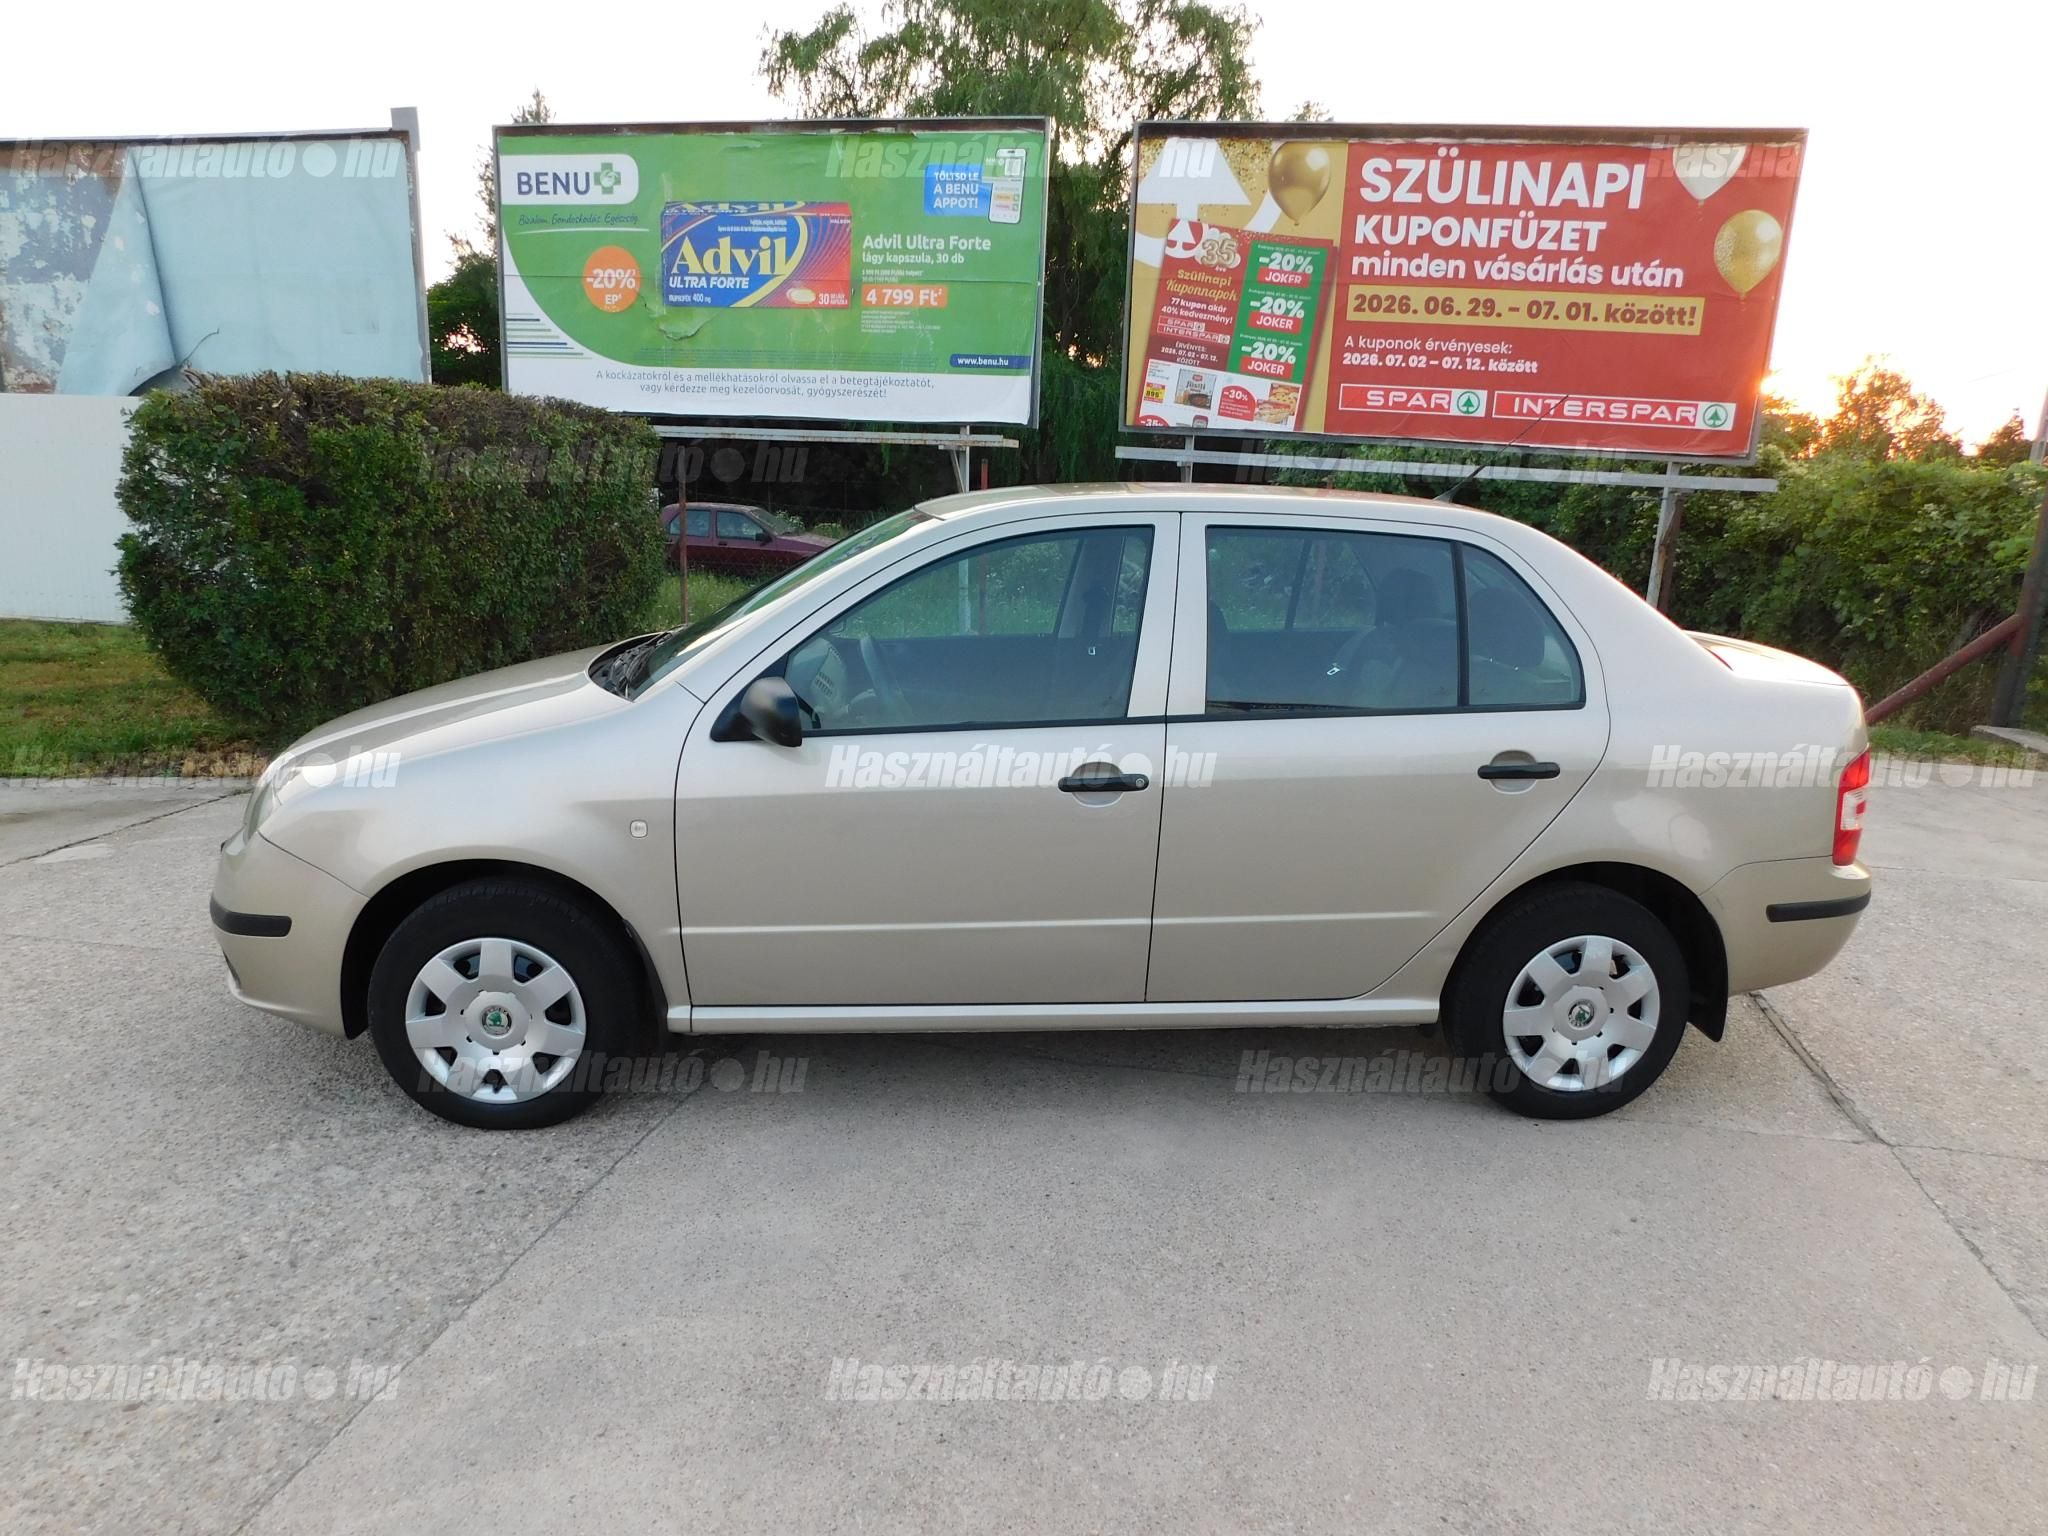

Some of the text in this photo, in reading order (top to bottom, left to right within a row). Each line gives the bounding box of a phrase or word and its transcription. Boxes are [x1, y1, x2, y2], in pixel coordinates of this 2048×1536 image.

[516, 172, 590, 196] BENU
[933, 170, 979, 181] TÖLTSD LE
[1360, 147, 1646, 210] SZÜLINAPI
[933, 184, 979, 195] A BENU
[933, 198, 978, 209] APPOT!
[1355, 210, 1607, 252] KUPONFÜZET
[862, 234, 991, 250] Advil Ultra Forte
[671, 236, 786, 275] Advil
[862, 251, 965, 265] lágy kapszula, 30 db
[1259, 252, 1314, 274] -20%
[1351, 250, 1684, 288] minden vásárlás után
[669, 276, 750, 289] ULTRA FORTE
[1177, 269, 1232, 288] Szülinapi
[1264, 271, 1302, 285] JOKER
[818, 293, 829, 305] 30
[866, 288, 877, 305] 4
[882, 288, 914, 305] 799
[1180, 298, 1207, 310] kupon
[1250, 296, 1305, 319] -20%
[1353, 293, 1419, 315] 2026.
[1424, 296, 1462, 316] 06.
[1466, 297, 1503, 318] 29.
[1526, 300, 1560, 321] 07.
[1565, 301, 1599, 323] 01.
[1604, 302, 1697, 327] között!
[1256, 315, 1294, 330] JOKER
[1241, 341, 1297, 365] -20%
[1344, 336, 1513, 356] A kuponok érvényesek:
[957, 356, 1009, 366] www.benu.hu
[1247, 361, 1285, 375] JOKER
[1342, 352, 1383, 366] 2026.
[1385, 354, 1406, 367] 07.
[1408, 355, 1427, 368] 02
[1441, 356, 1463, 370] 07.
[1466, 358, 1486, 371] 12.
[1488, 358, 1539, 373] között
[596, 370, 603, 378] A
[605, 370, 671, 381] kockázatokról
[673, 373, 684, 381] és
[694, 372, 778, 383] mellékhatásokról
[780, 374, 817, 384] olvassa
[819, 375, 829, 384] el
[640, 384, 662, 393] vagy
[664, 384, 707, 393] kérdezze
[709, 386, 730, 395] meg
[1366, 390, 1450, 410] SPAR
[1513, 397, 1697, 424] INTERSPAR
